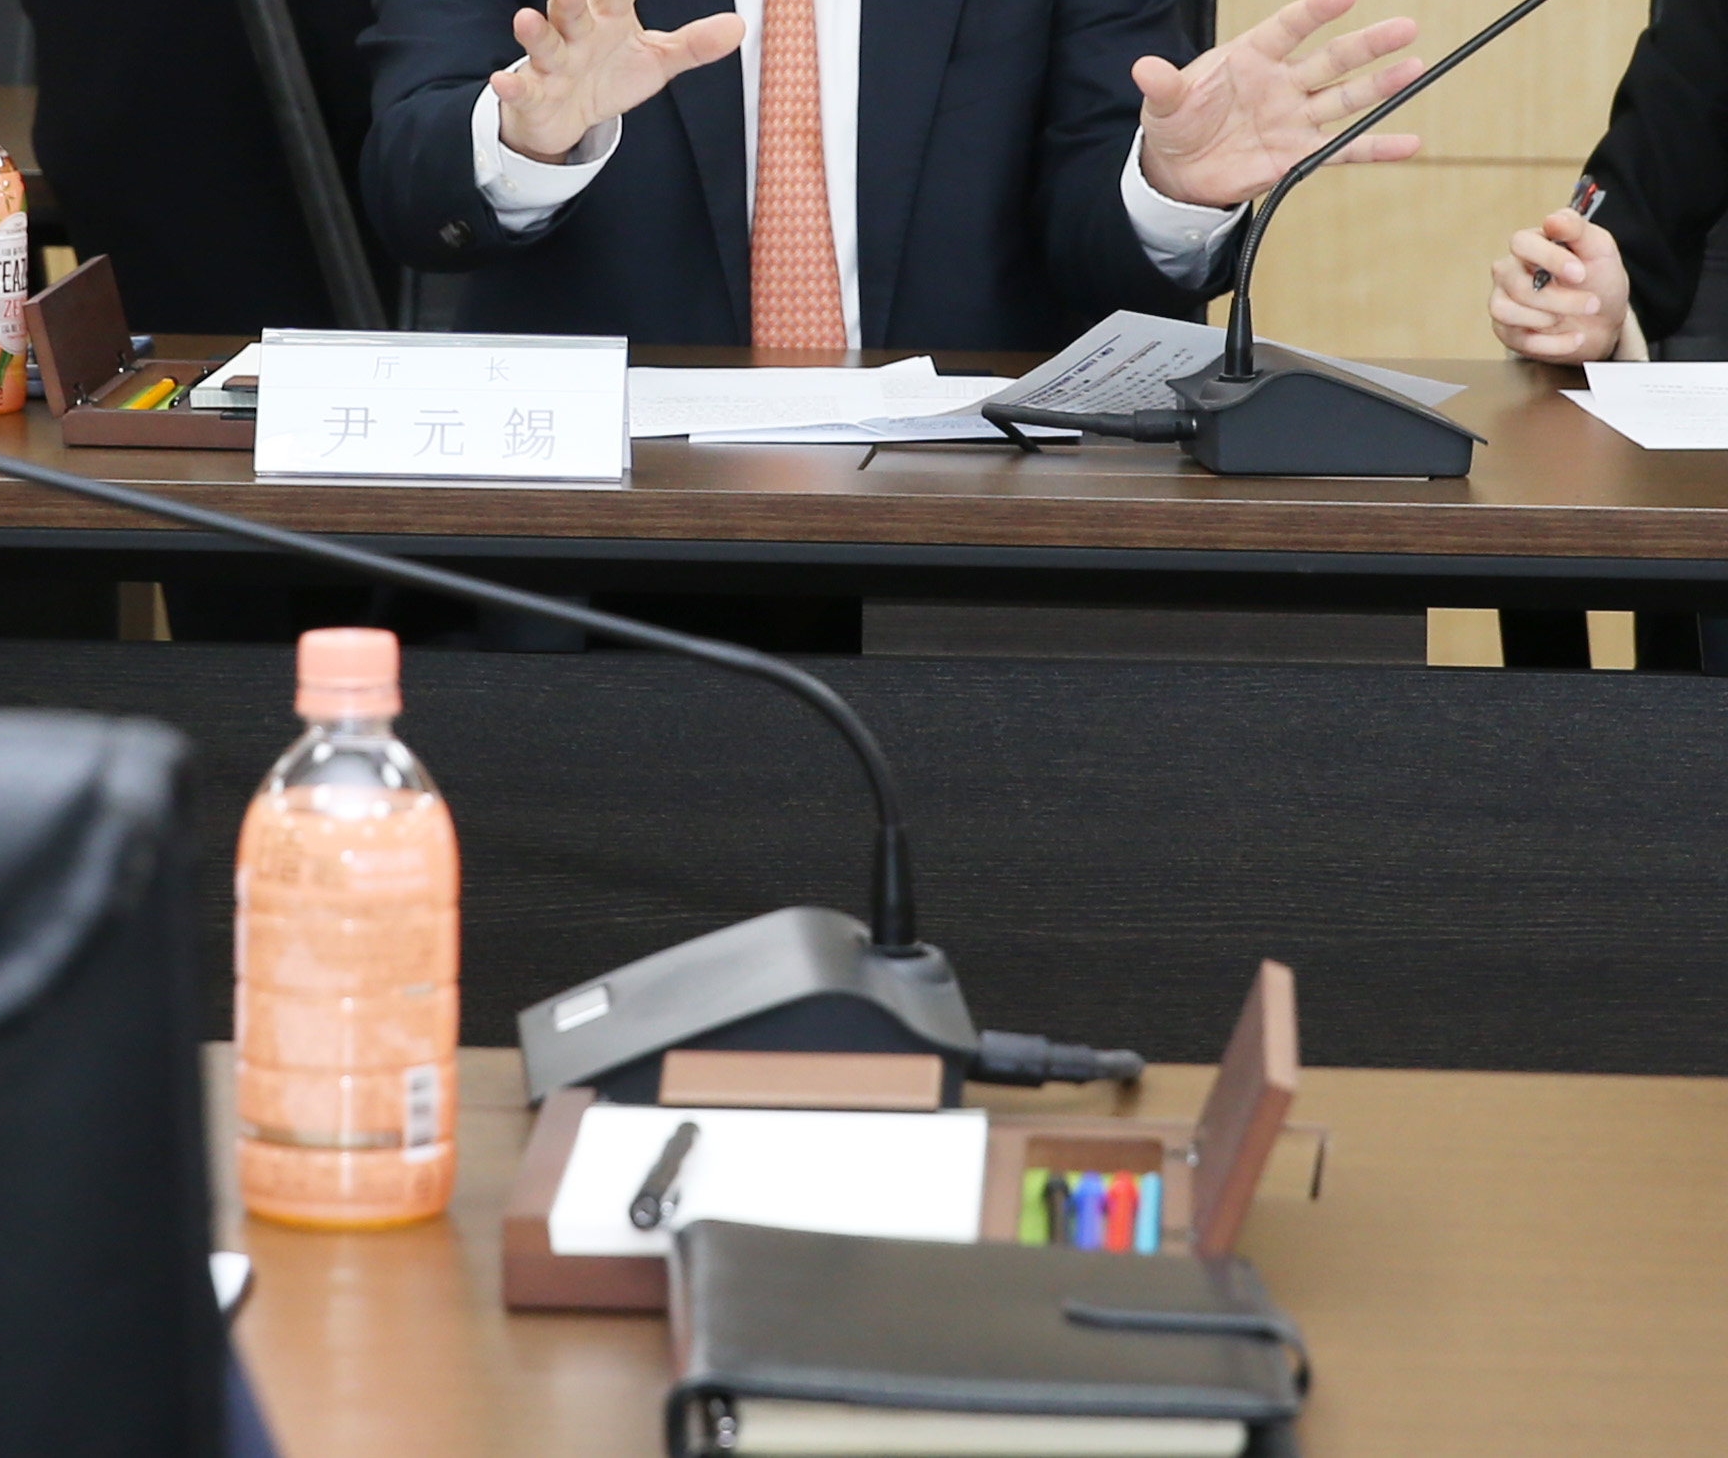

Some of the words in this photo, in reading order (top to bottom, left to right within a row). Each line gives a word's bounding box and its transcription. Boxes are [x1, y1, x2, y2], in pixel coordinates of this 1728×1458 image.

[373, 356, 510, 382] 厅长
[320, 406, 556, 460] 尹元錫
